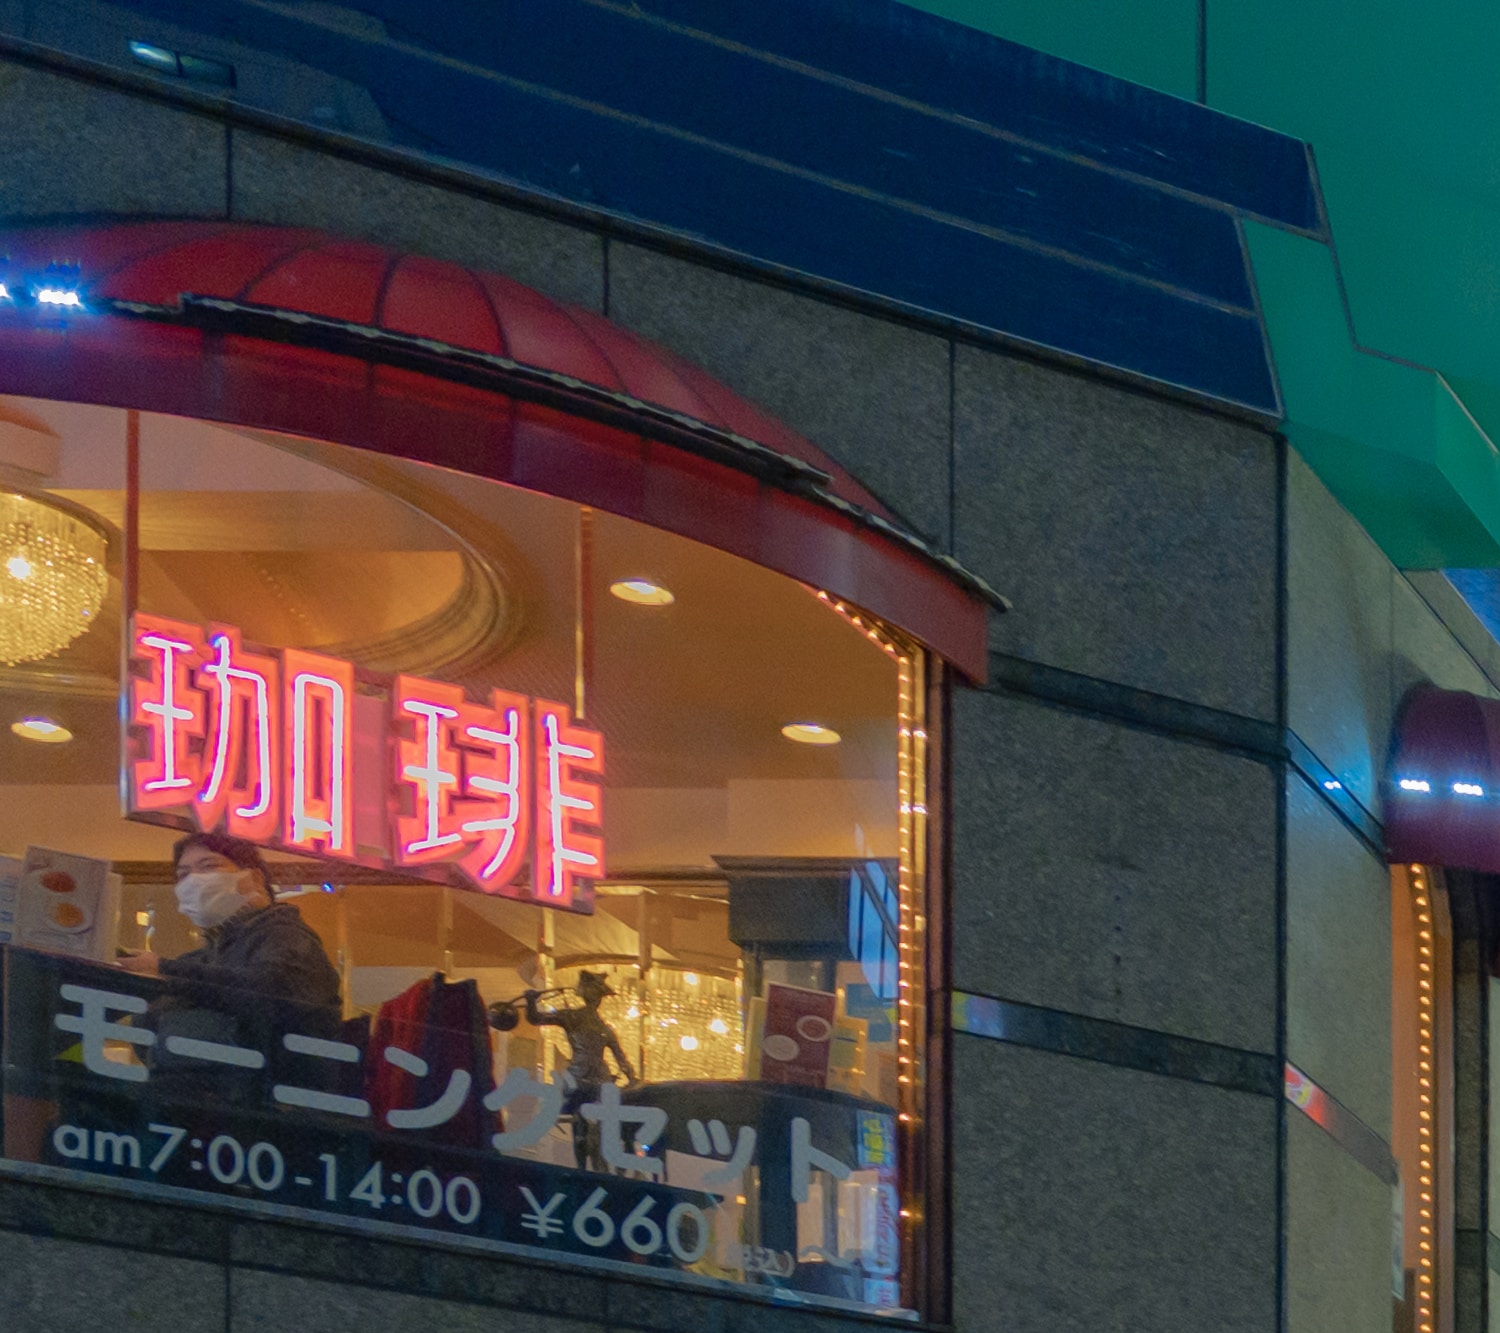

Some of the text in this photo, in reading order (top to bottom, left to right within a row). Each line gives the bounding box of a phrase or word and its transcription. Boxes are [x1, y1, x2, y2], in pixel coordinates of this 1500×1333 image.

[138, 622, 601, 905] 珈琲
[55, 984, 850, 1200] モーニングセット
[519, 1187, 710, 1263] ¥660
